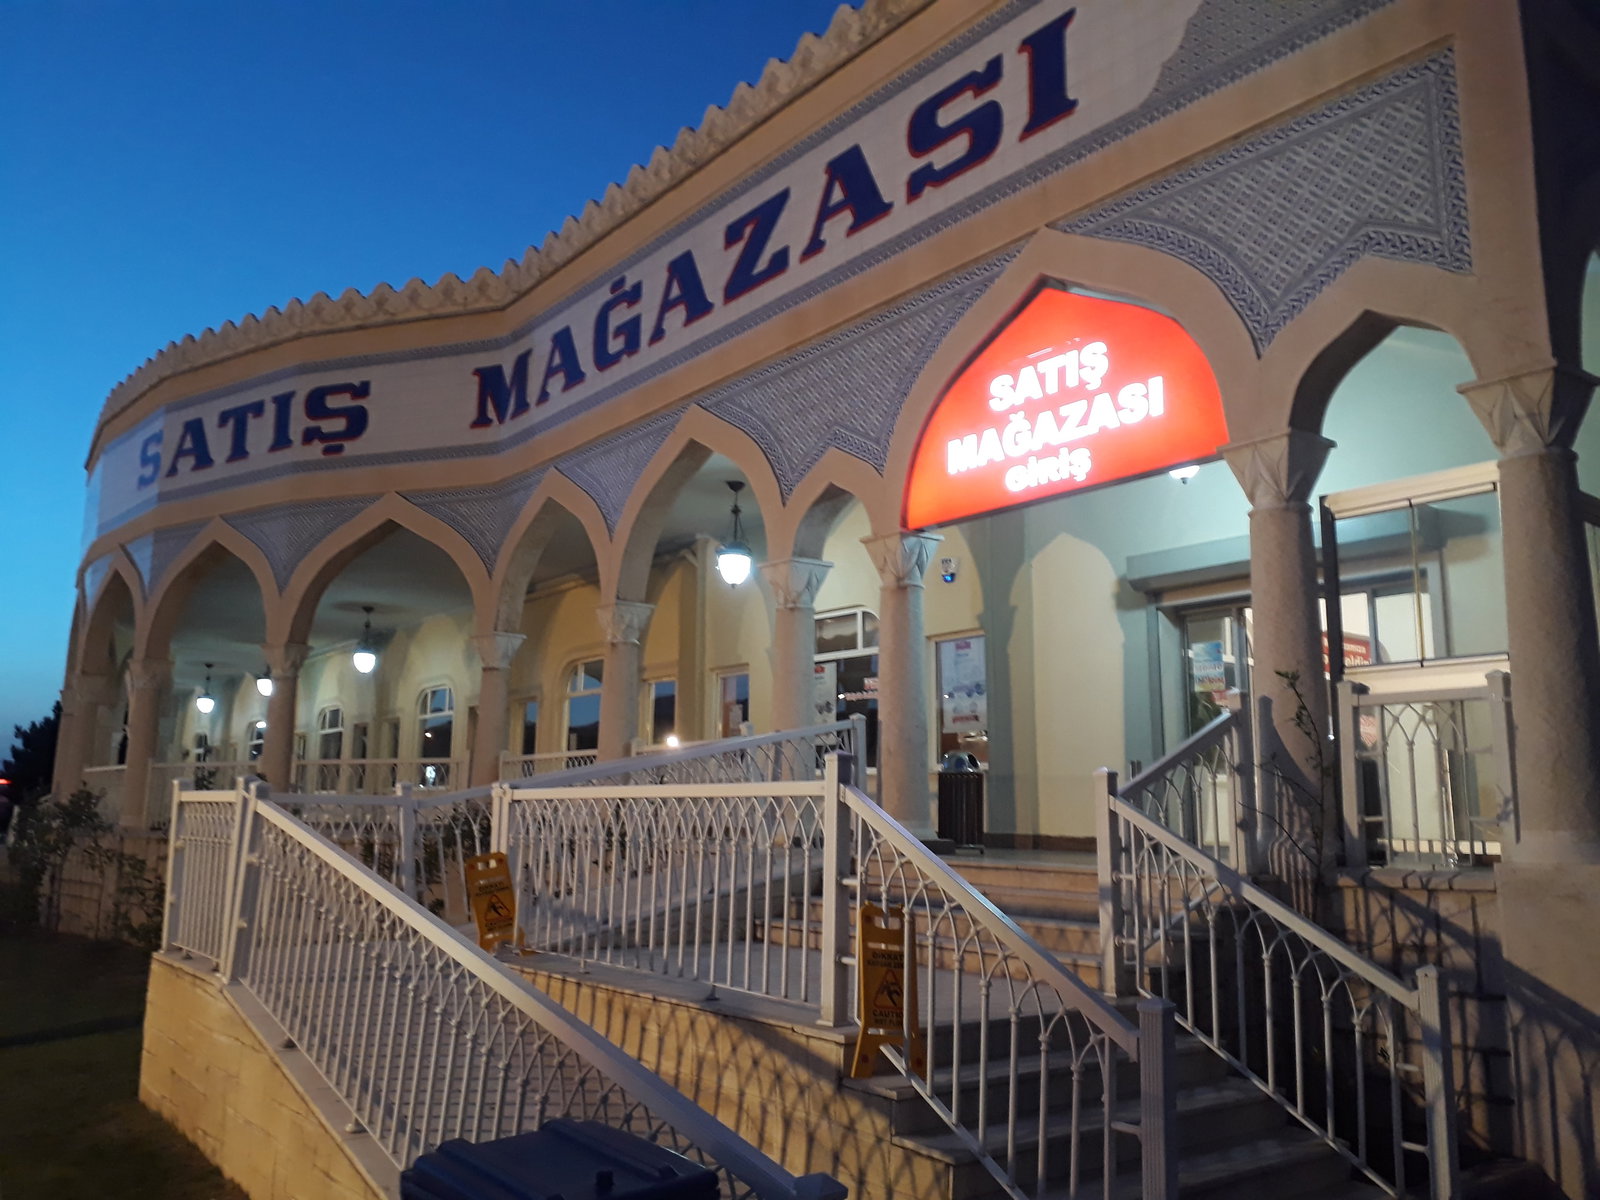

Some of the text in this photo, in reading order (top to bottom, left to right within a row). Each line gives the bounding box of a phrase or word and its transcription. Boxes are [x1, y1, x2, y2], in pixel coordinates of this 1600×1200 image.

[137, 6, 1078, 491] SATIŞ MAĞAZASI
[988, 341, 1109, 412] SATIŞ
[947, 376, 1164, 475] MAĞAZASI
[872, 1009, 904, 1018] CAUTIO
